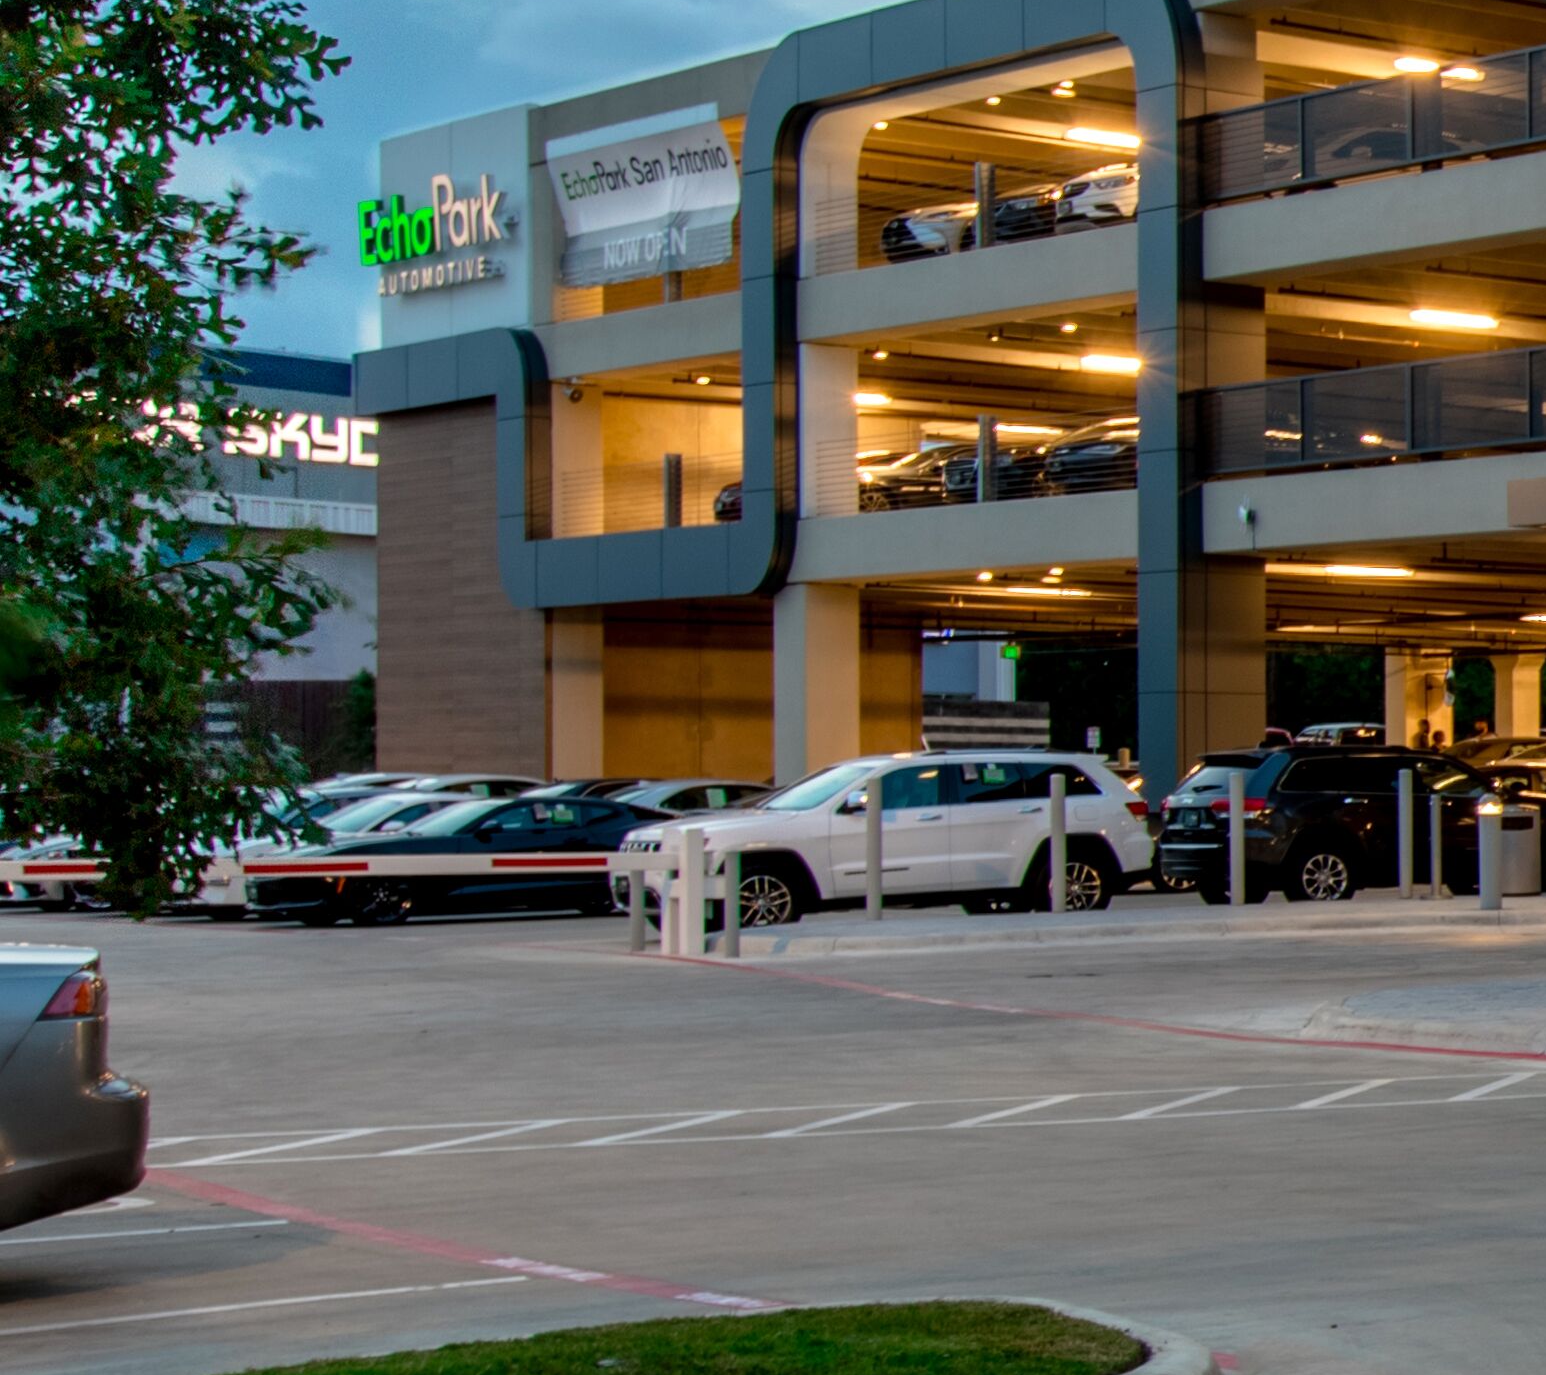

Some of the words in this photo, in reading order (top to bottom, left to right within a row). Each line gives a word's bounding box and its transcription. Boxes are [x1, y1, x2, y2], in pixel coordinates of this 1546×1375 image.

[561, 160, 631, 200] EchoPark
[629, 156, 665, 185] San
[667, 139, 728, 176] Antonio
[358, 173, 506, 267] EchoPark
[378, 256, 486, 298] AUTOMOTIVE
[604, 237, 640, 269] NOW
